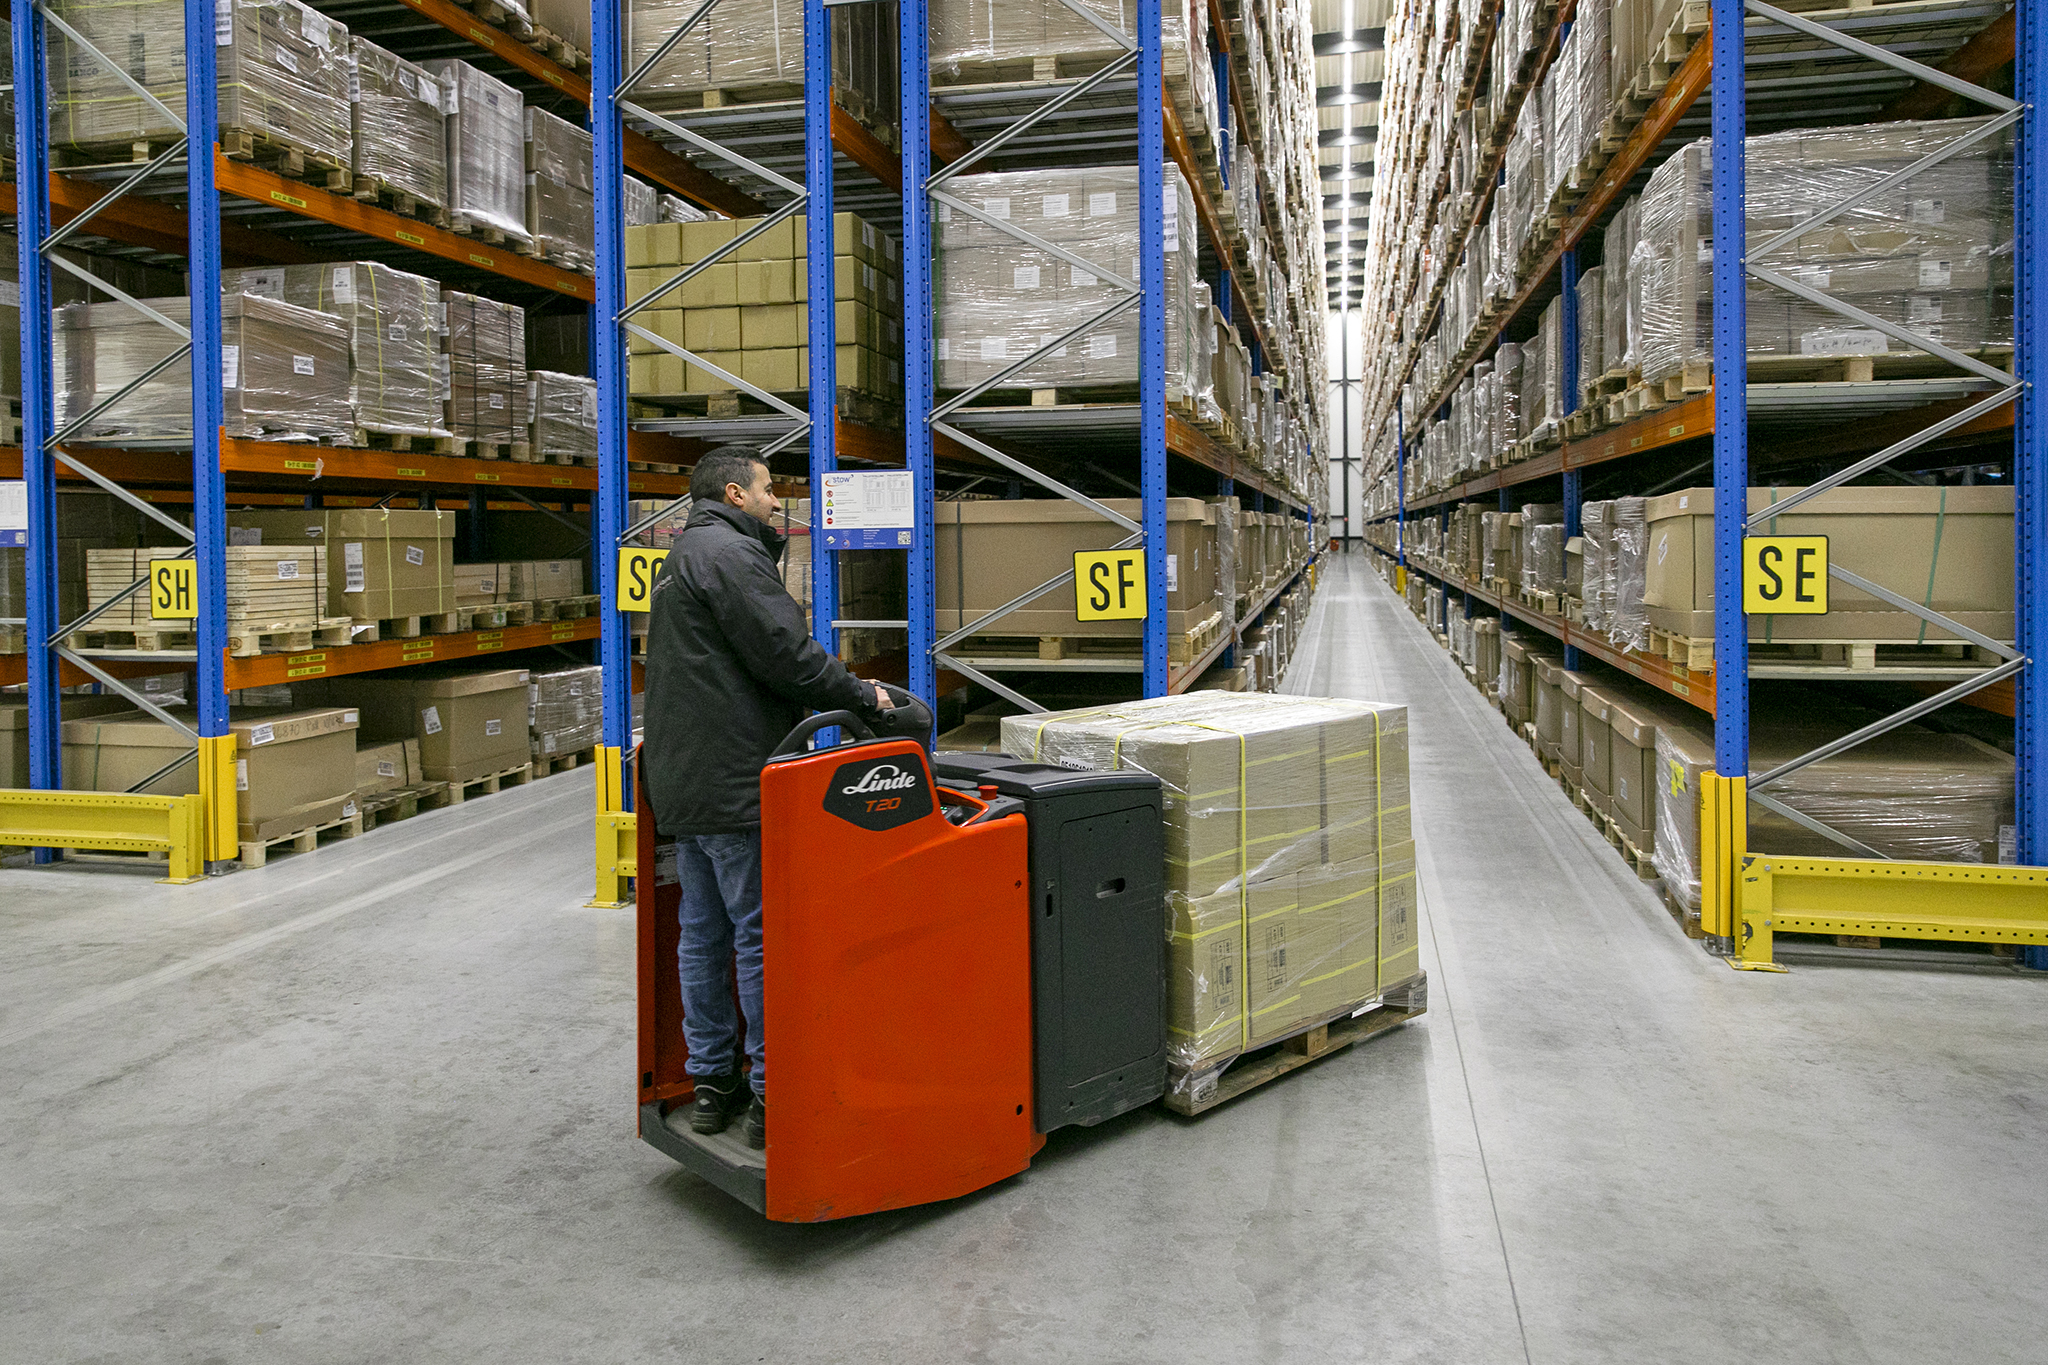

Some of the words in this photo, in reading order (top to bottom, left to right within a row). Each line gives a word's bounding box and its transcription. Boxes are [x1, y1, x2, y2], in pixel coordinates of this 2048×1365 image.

[157, 567, 190, 611] SH
[1089, 559, 1135, 612] SF
[1759, 545, 1816, 602] SE
[842, 764, 916, 795] Linde
[866, 797, 901, 813] T20
